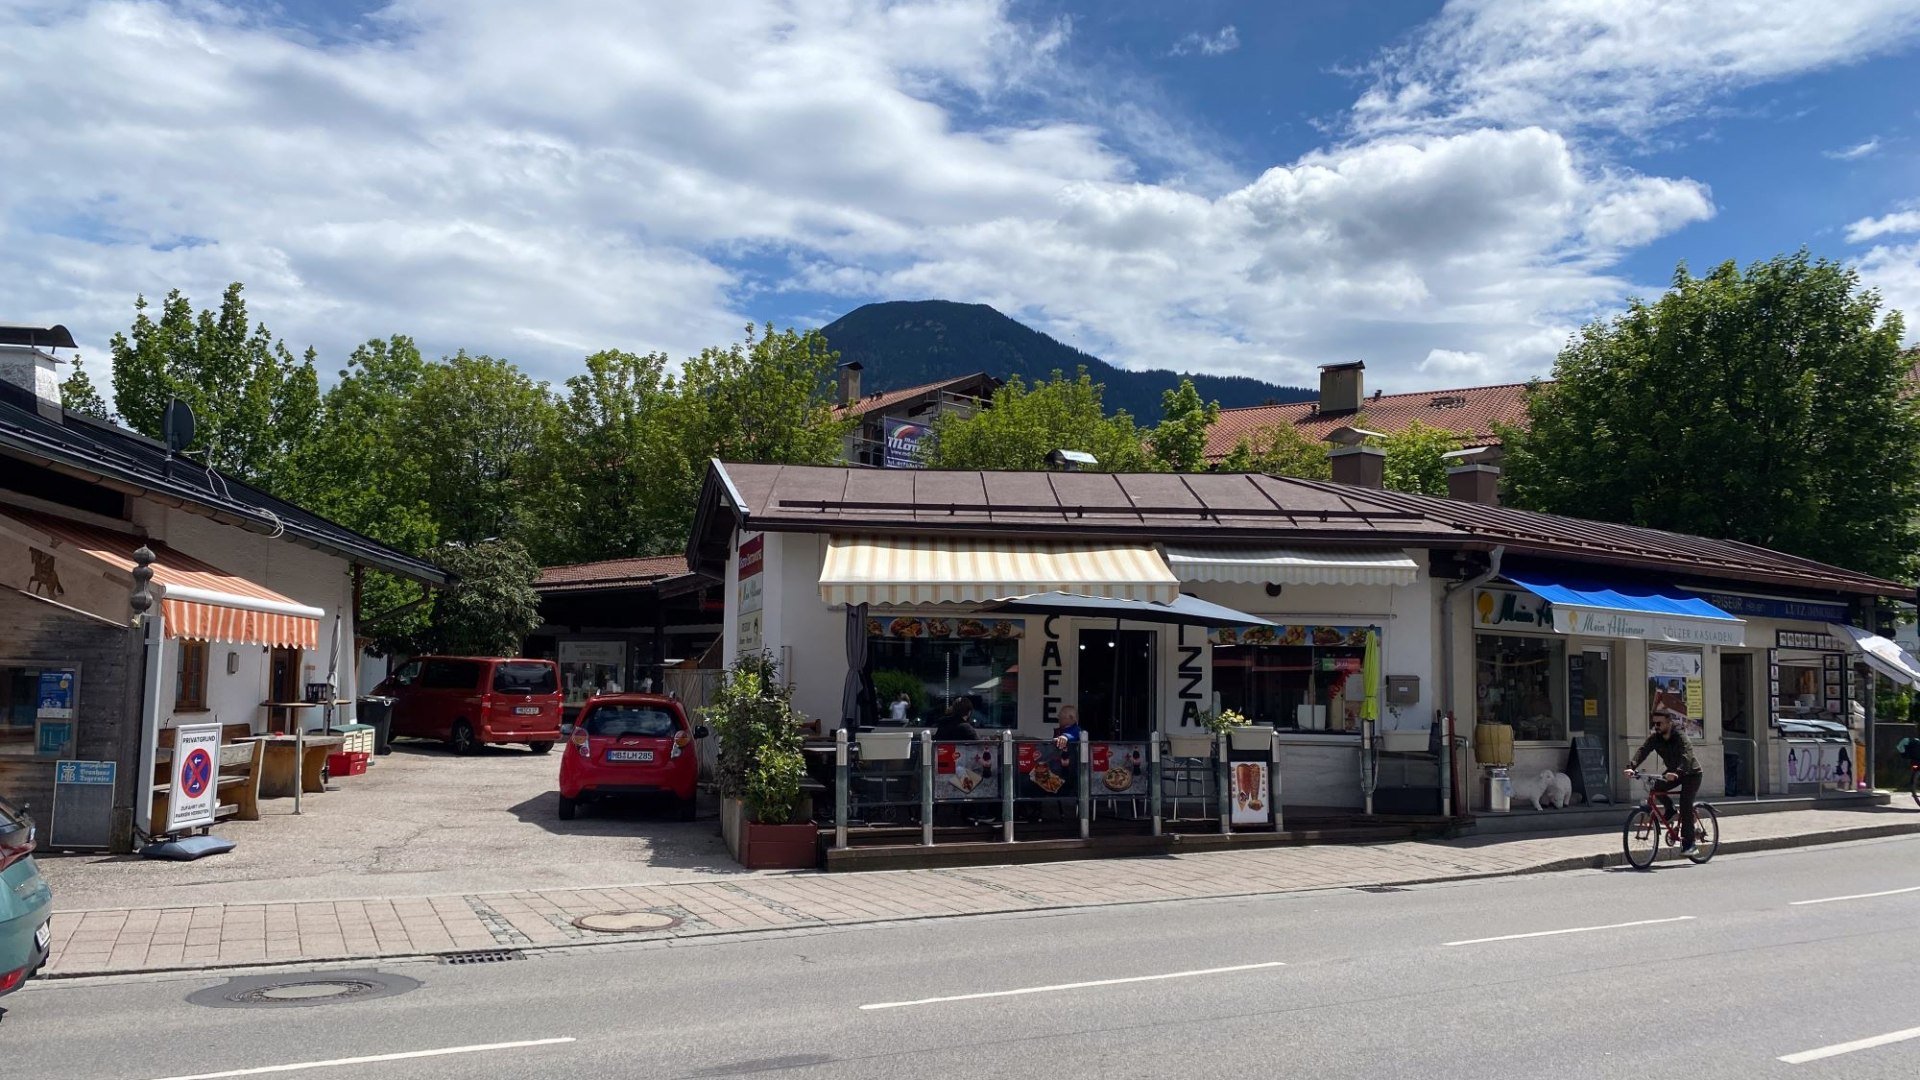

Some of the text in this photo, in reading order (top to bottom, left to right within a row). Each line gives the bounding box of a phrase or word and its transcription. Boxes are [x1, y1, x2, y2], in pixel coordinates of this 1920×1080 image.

[1711, 594, 1743, 611] FRISEUR
[1582, 612, 1645, 636] Mein Affineur
[1663, 625, 1733, 642] TÖLZER KASLADEN
[1041, 615, 1062, 723] CAFE
[1178, 624, 1203, 727] IZZA
[183, 735, 216, 744] PRIVATGRUND
[638, 752, 653, 760] 285
